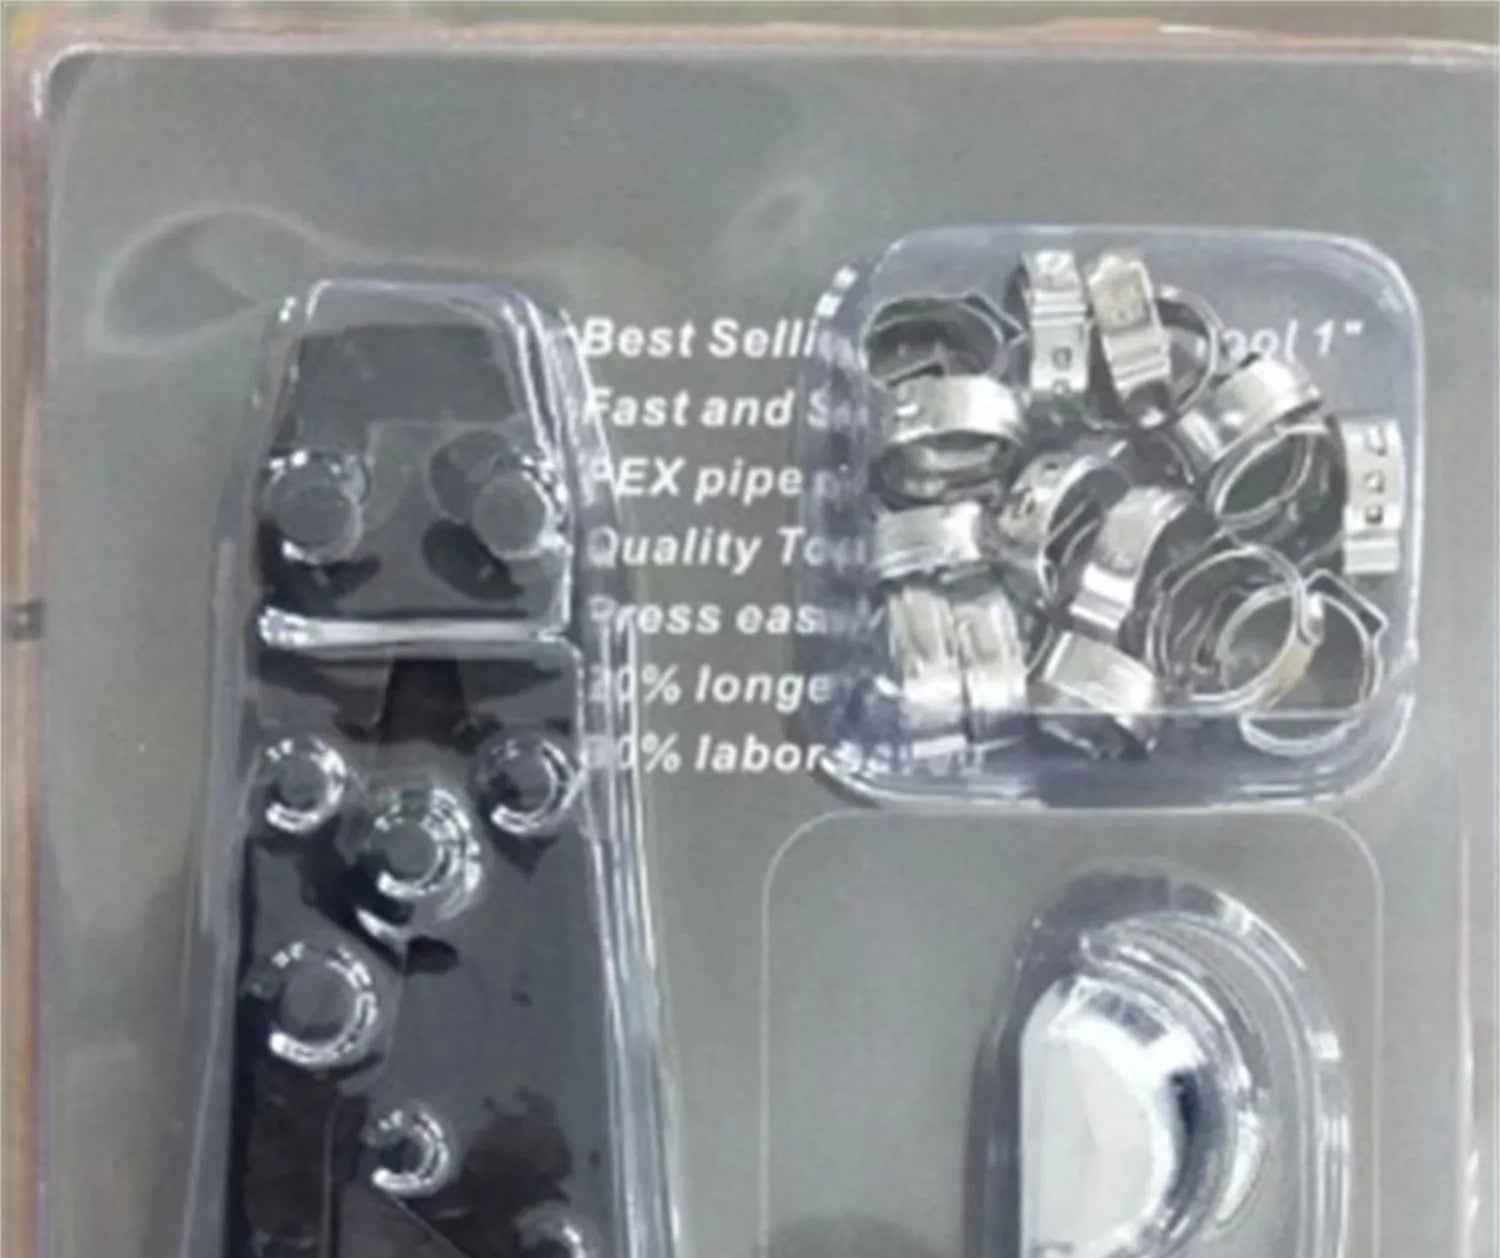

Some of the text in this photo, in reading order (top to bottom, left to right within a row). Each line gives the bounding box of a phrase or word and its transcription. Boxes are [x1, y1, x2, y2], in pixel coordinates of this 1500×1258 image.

[583, 316, 696, 358] Best
[707, 317, 850, 364] Selli
[583, 386, 691, 428] Fast
[699, 389, 795, 428] and
[588, 456, 687, 500] PEX
[694, 457, 805, 506] pipe
[585, 526, 763, 577] Quality
[588, 594, 722, 635] Press
[694, 663, 848, 714] longe
